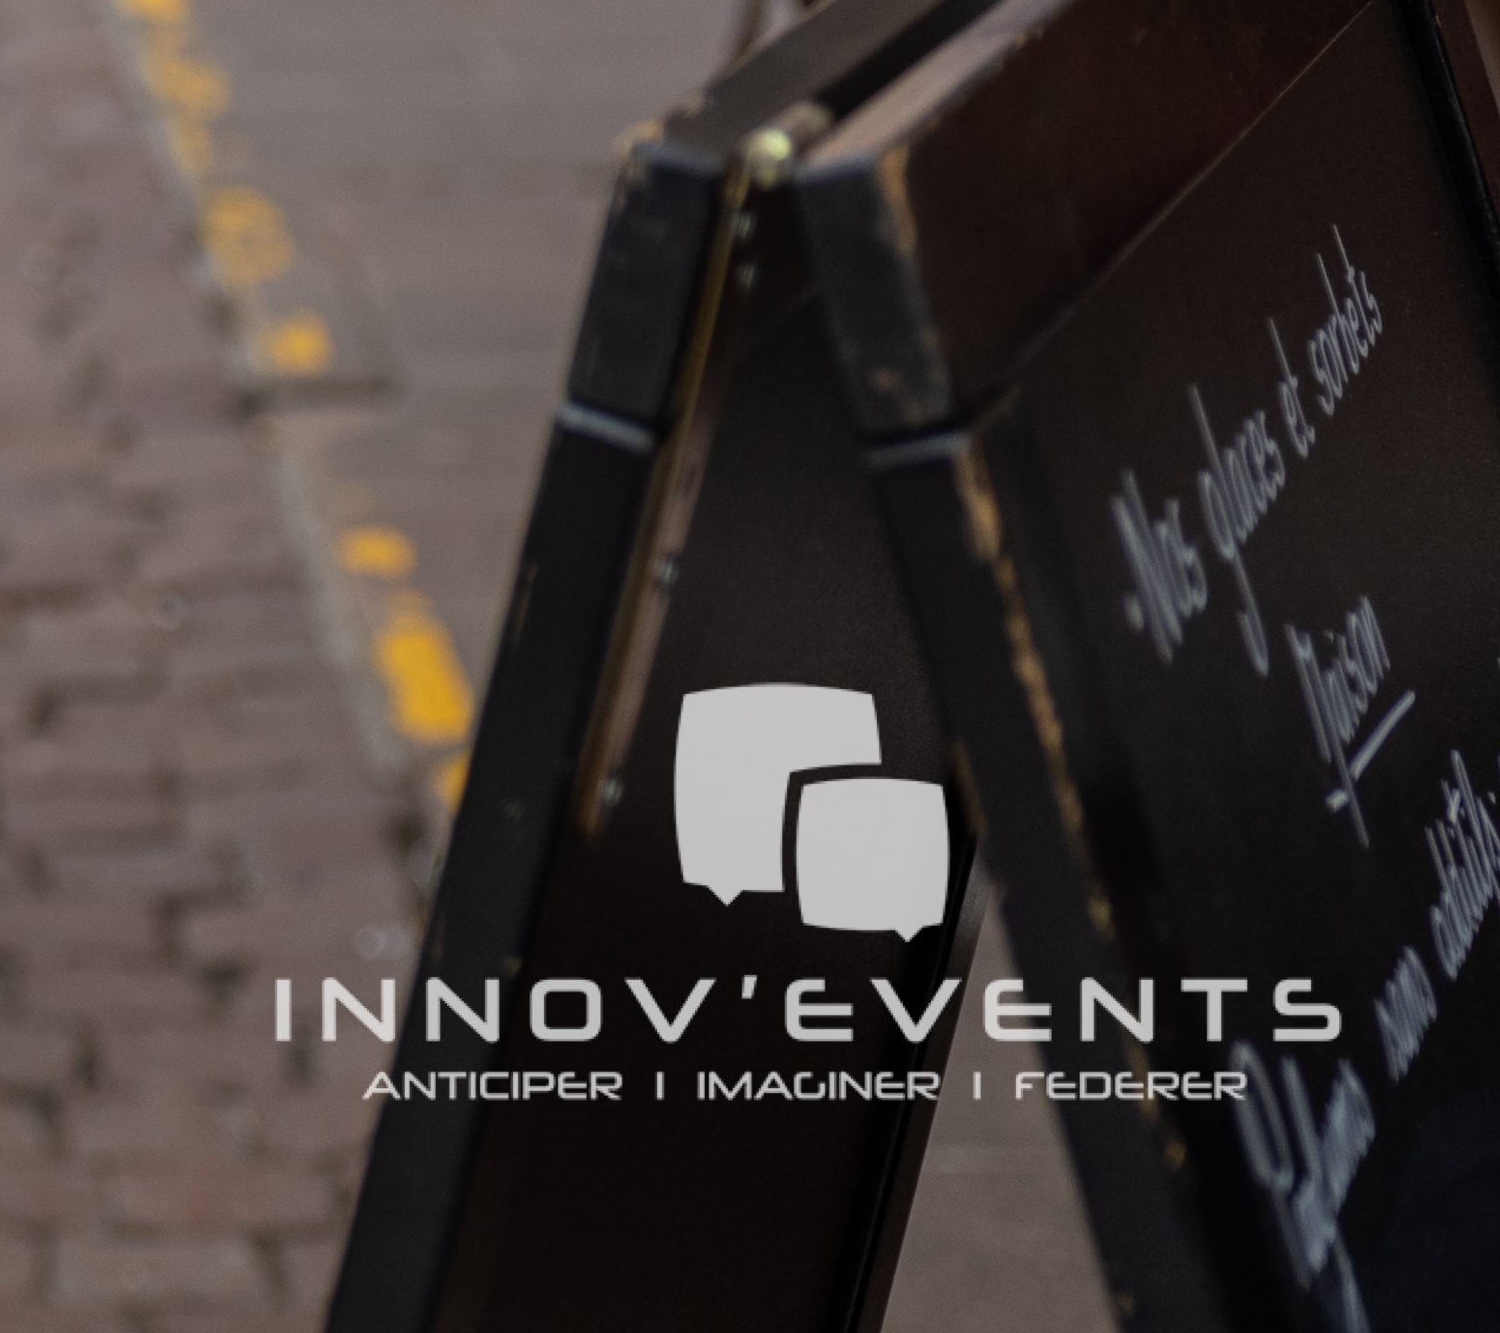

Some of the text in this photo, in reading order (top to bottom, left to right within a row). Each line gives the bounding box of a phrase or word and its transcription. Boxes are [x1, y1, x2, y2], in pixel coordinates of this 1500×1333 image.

[1111, 222, 1384, 678] Nos glaces et sorbets
[1284, 595, 1391, 847] Maison
